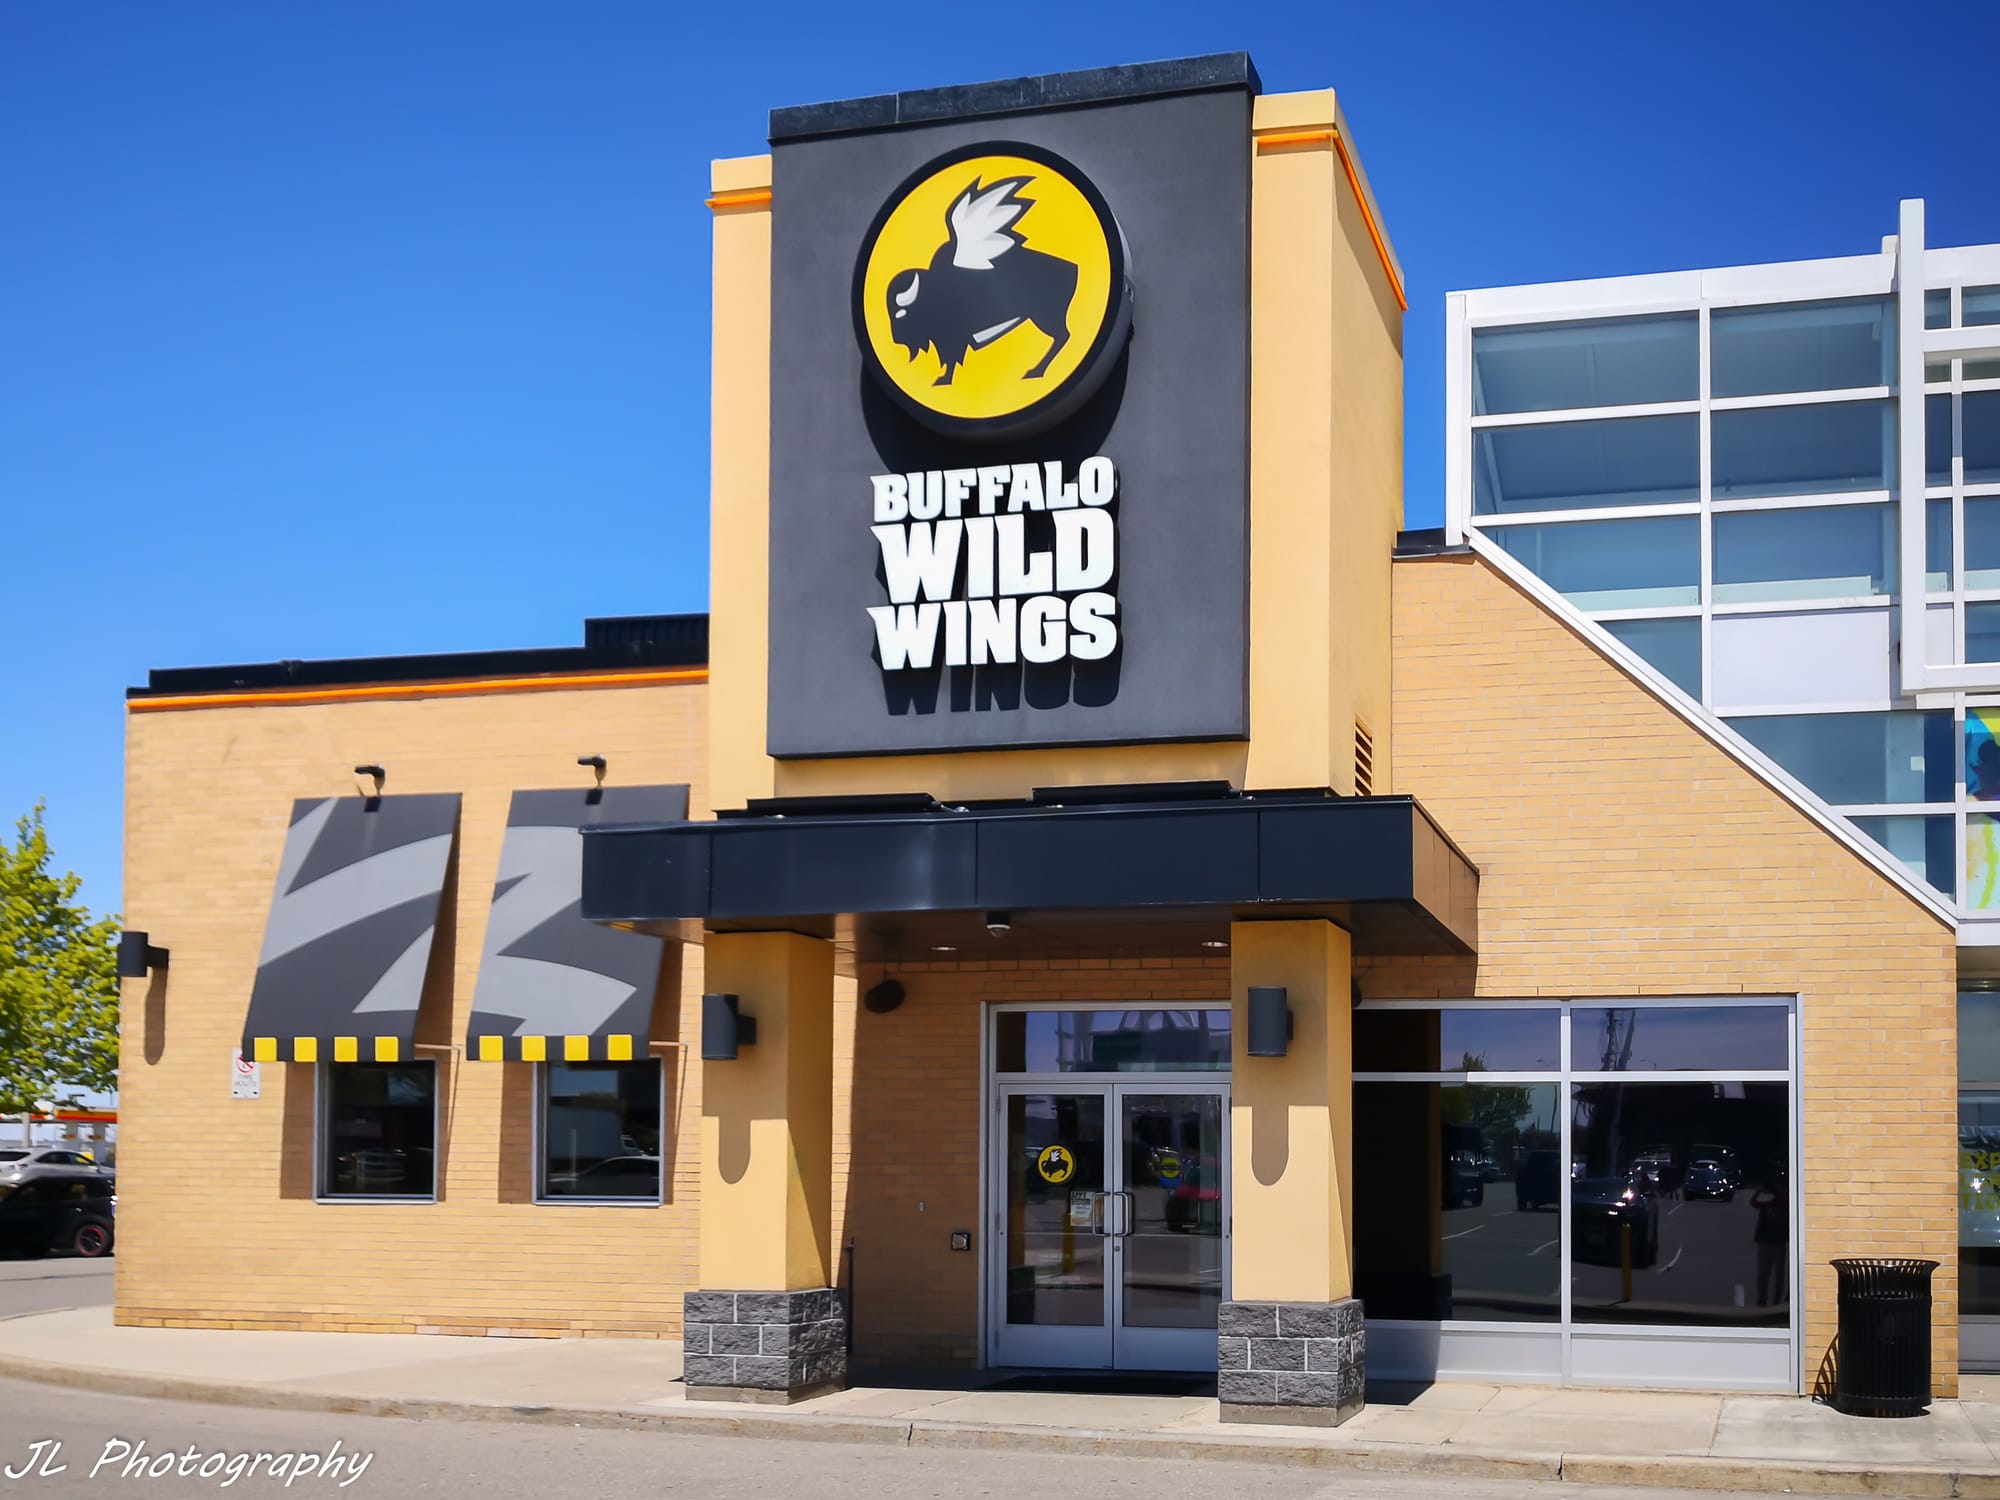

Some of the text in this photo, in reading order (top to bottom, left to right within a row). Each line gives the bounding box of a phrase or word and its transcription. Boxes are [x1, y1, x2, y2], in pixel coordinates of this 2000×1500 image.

[870, 456, 1116, 523] BUFFALO
[870, 507, 1116, 604] WILD
[865, 592, 1118, 671] WINGS
